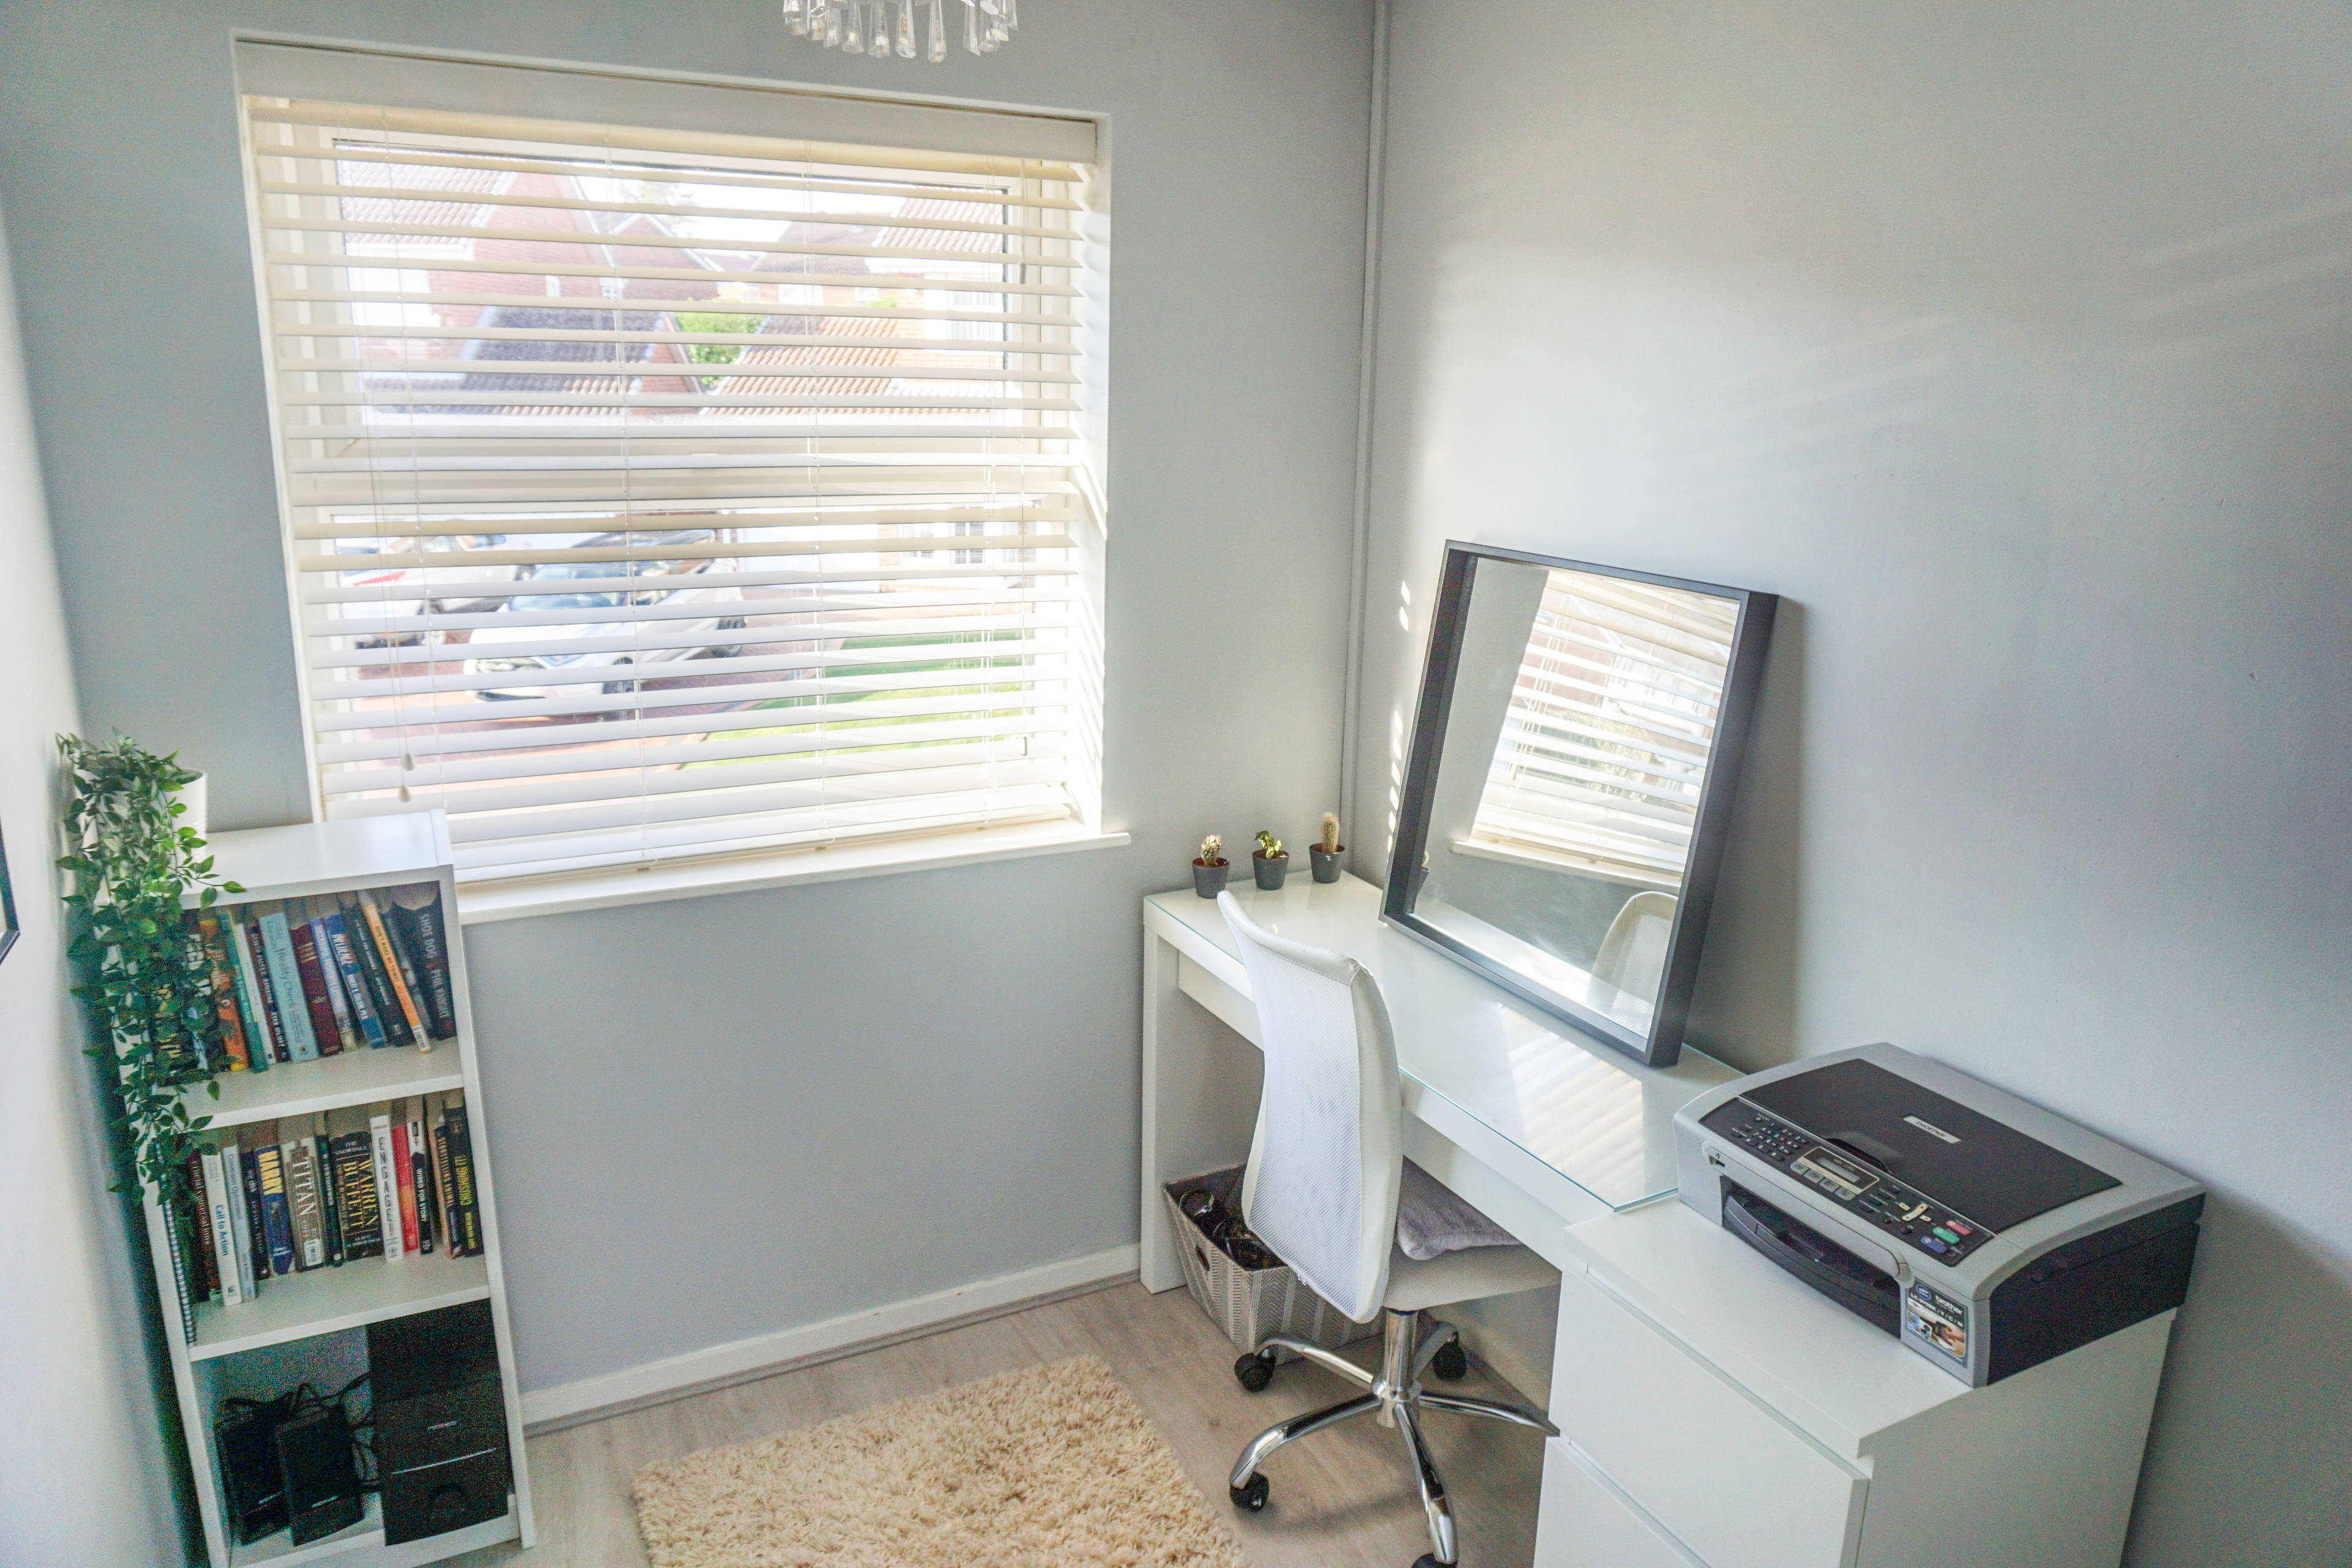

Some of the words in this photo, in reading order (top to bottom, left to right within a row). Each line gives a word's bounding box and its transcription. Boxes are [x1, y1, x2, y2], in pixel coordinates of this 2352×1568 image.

[258, 1150, 284, 1195] HARRY
[292, 1156, 317, 1216] TITAN
[343, 1161, 364, 1227] BUFFETT
[358, 1159, 380, 1227] WARREN
[216, 1205, 227, 1221] Call
[217, 1221, 225, 1229] to
[419, 1203, 428, 1222] STORY
[219, 1231, 230, 1256] Action
